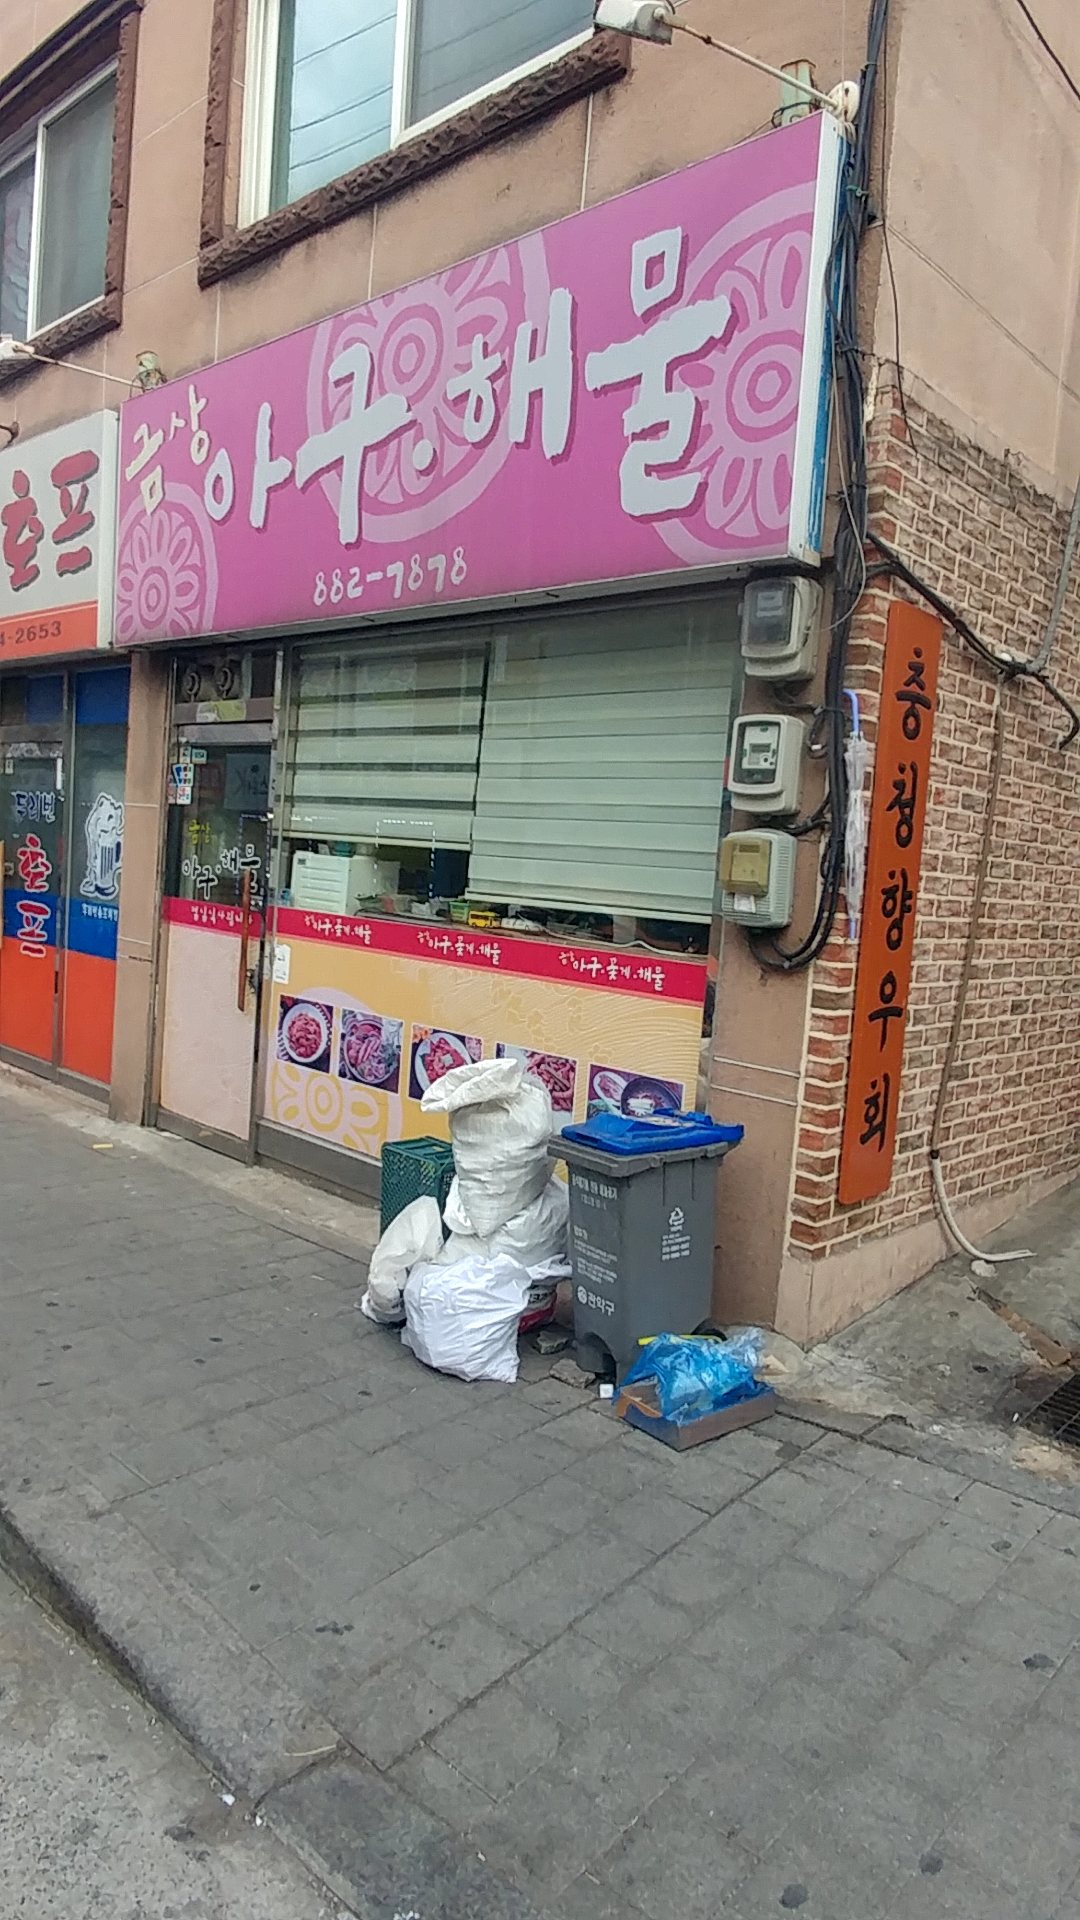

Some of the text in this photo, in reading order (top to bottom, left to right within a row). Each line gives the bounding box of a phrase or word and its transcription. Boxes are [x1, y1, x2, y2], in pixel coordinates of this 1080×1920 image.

[126, 384, 209, 515] 금상
[1, 450, 99, 592] 호프
[312, 546, 468, 607] 882-7878
[188, 819, 210, 845] 금상
[17, 833, 52, 957] 호프
[860, 647, 932, 1153] 충청향우회
[587, 1291, 616, 1317] 관악구
